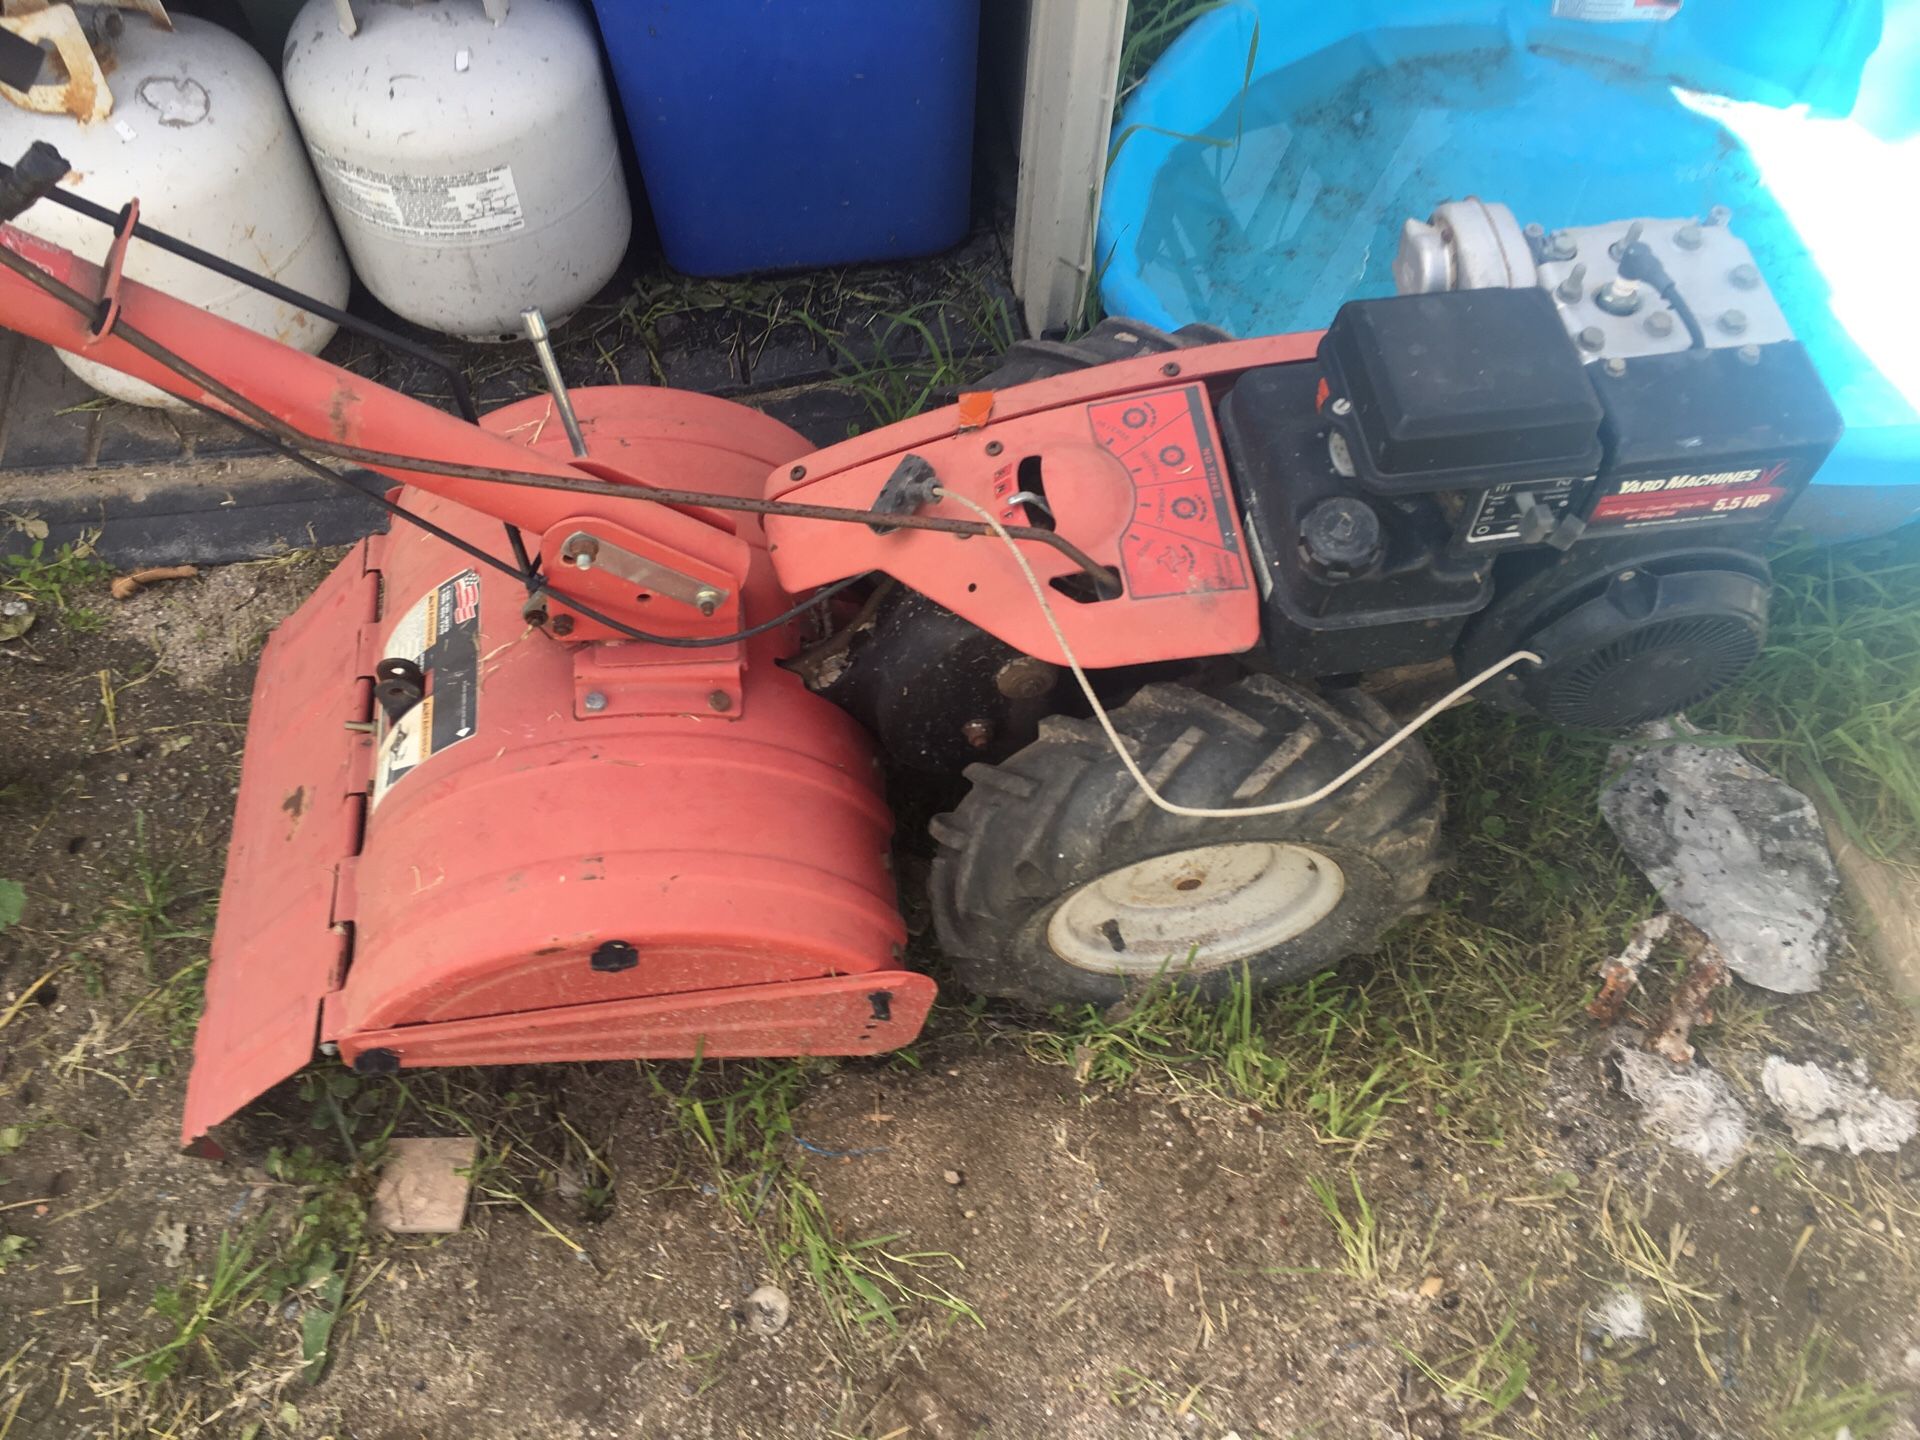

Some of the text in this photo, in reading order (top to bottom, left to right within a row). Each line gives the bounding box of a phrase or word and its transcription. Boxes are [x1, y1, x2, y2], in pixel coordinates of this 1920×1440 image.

[1201, 448, 1223, 499] NO TINES
[1618, 469, 1762, 495] YARD MACHINES
[1712, 497, 1741, 512] 5.5
[1741, 494, 1772, 509] HP
